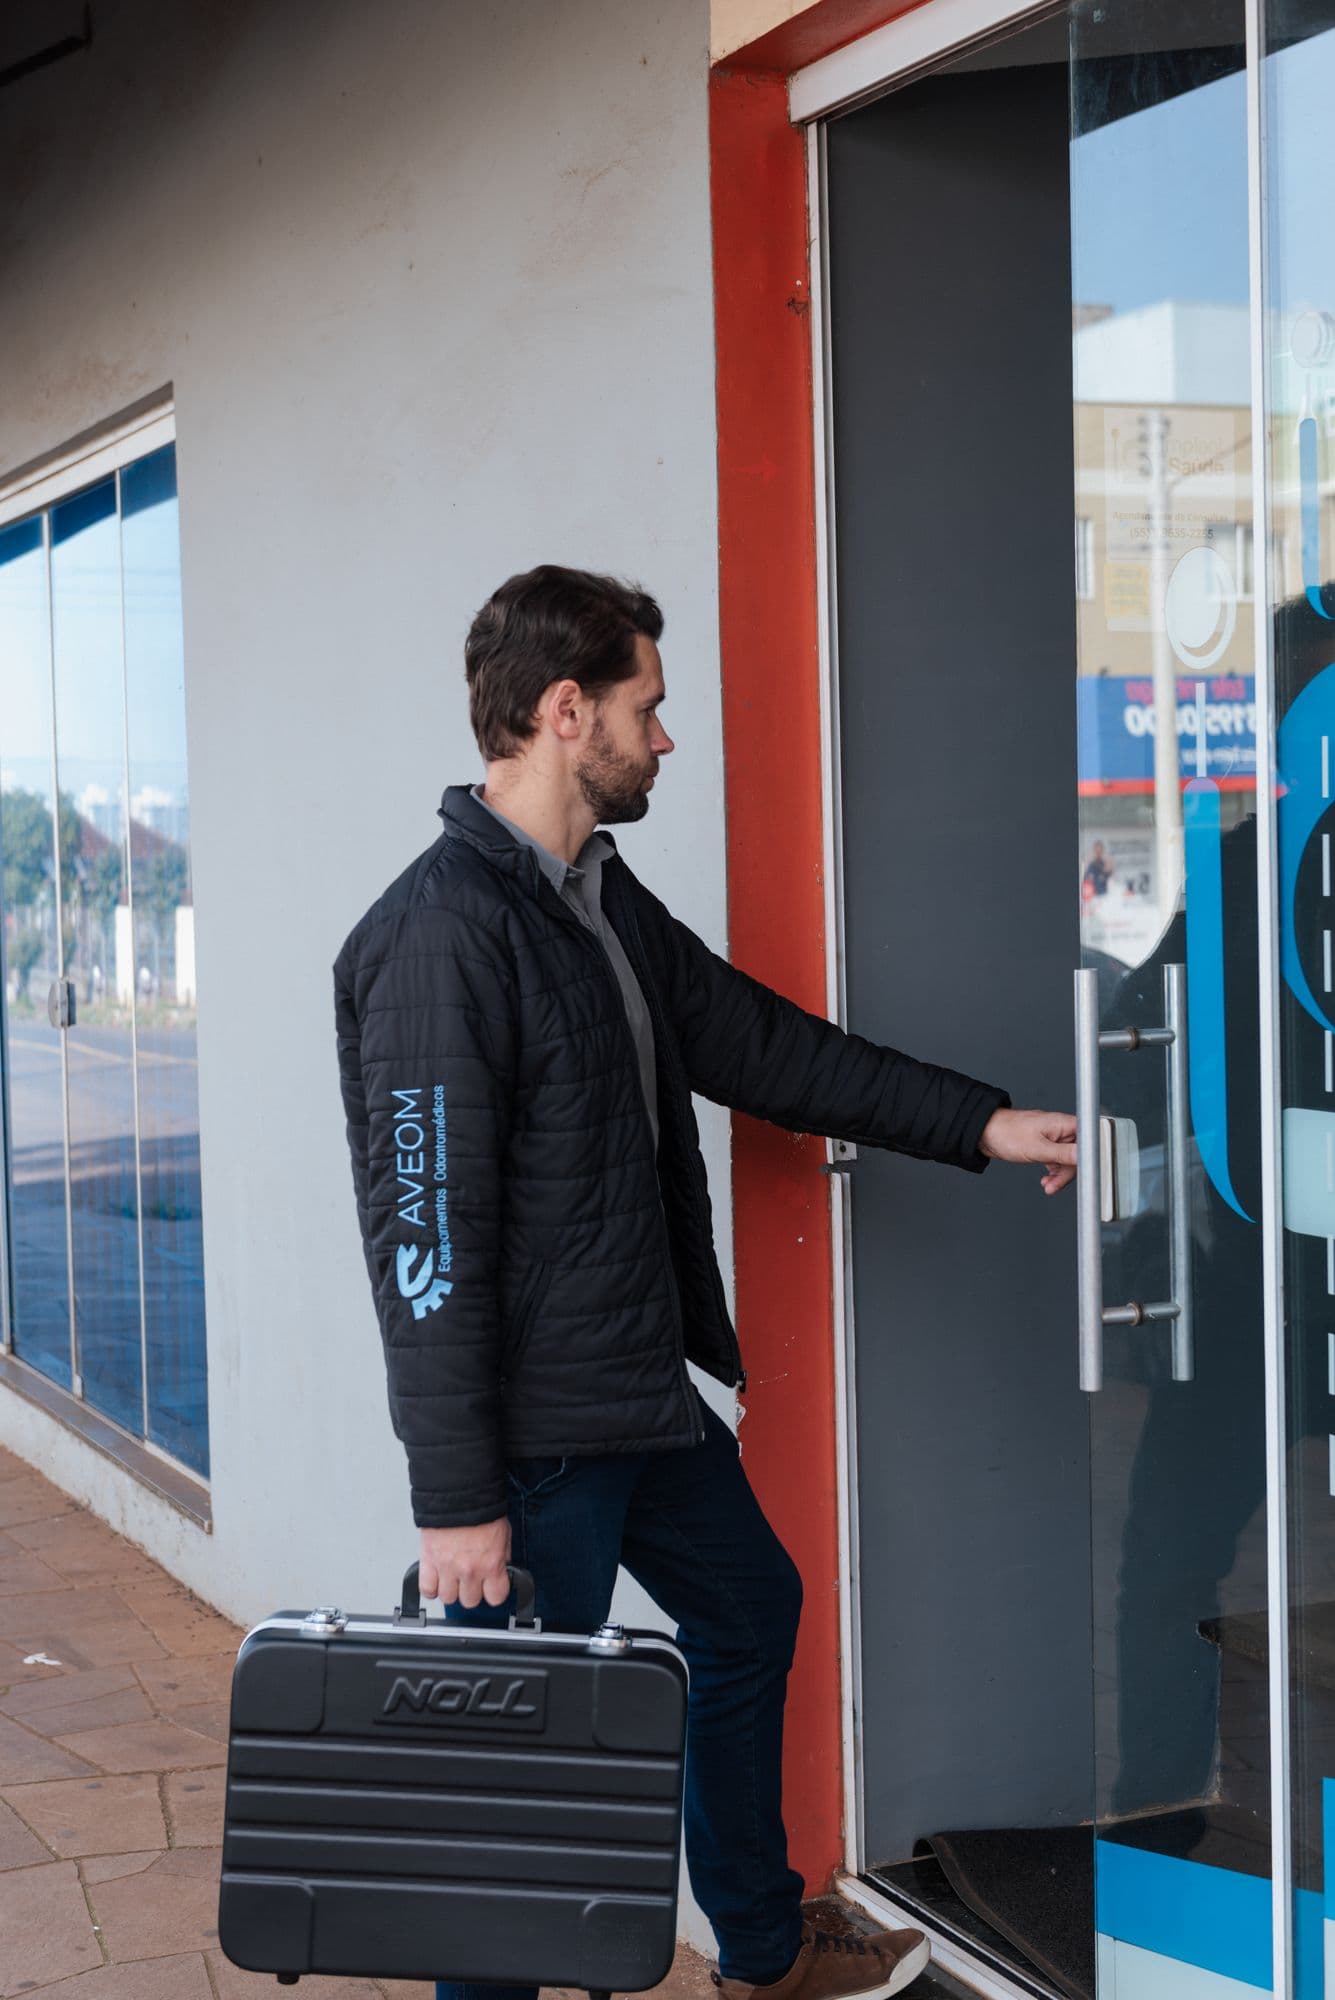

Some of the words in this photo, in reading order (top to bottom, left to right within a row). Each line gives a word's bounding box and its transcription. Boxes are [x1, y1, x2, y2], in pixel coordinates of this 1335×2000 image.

[391, 1088, 427, 1227] AVEOM
[433, 1084, 447, 1182] Odontomédicos
[434, 1186, 452, 1273] Equipamentos
[383, 1675, 537, 1718] NOLL
